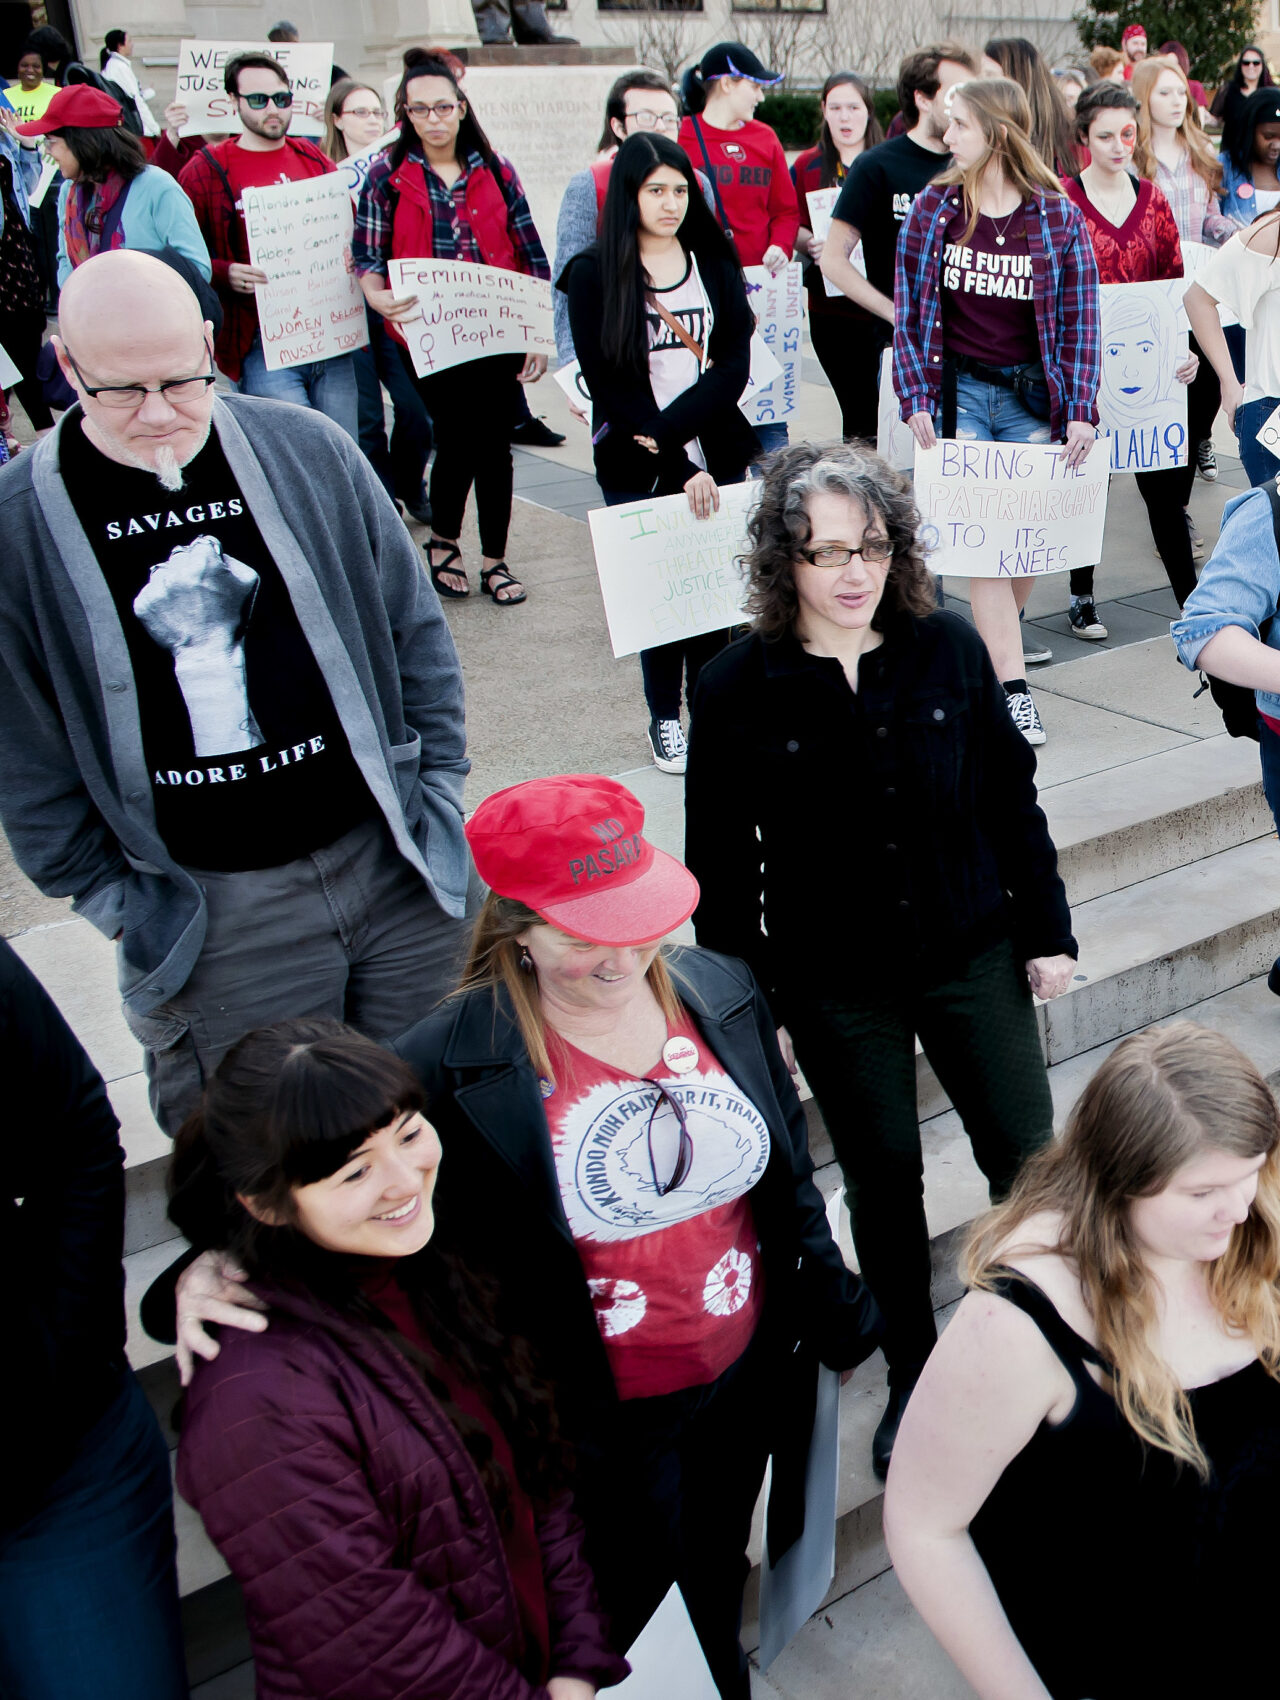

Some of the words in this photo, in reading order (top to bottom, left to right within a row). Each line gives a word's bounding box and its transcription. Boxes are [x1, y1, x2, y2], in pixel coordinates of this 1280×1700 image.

[179, 75, 225, 91] JUS
[740, 165, 771, 187] RED
[250, 218, 294, 238] Evelyn
[268, 268, 301, 280] usanna
[943, 243, 973, 270] THE
[976, 251, 1034, 278] FUTUR
[400, 261, 525, 293] Feminism:
[944, 266, 961, 290] IS
[264, 315, 322, 342] WOMEN
[421, 303, 488, 326] Women
[499, 306, 524, 321] Are
[311, 329, 325, 340] IN
[451, 323, 505, 348] People
[518, 324, 556, 346] Too
[783, 326, 800, 353] IS
[279, 341, 326, 365] MUSIC
[782, 362, 796, 415] WOMAN
[941, 442, 1034, 480] BRING
[1095, 425, 1161, 470] LALA
[928, 481, 1103, 522] PATRIARCHY
[106, 498, 243, 540] SAVAGES
[947, 522, 986, 549] TO
[1014, 527, 1049, 550] ITS
[997, 545, 1069, 577] KNEES
[663, 568, 729, 602] JUSTICE
[155, 763, 248, 786] ADORE
[259, 735, 326, 774] LIFE
[590, 818, 624, 845] NO
[569, 830, 642, 885] PASARA
[592, 1113, 626, 1149] NOH
[617, 1092, 660, 1122] FAIN
[700, 1090, 722, 1111] IT,
